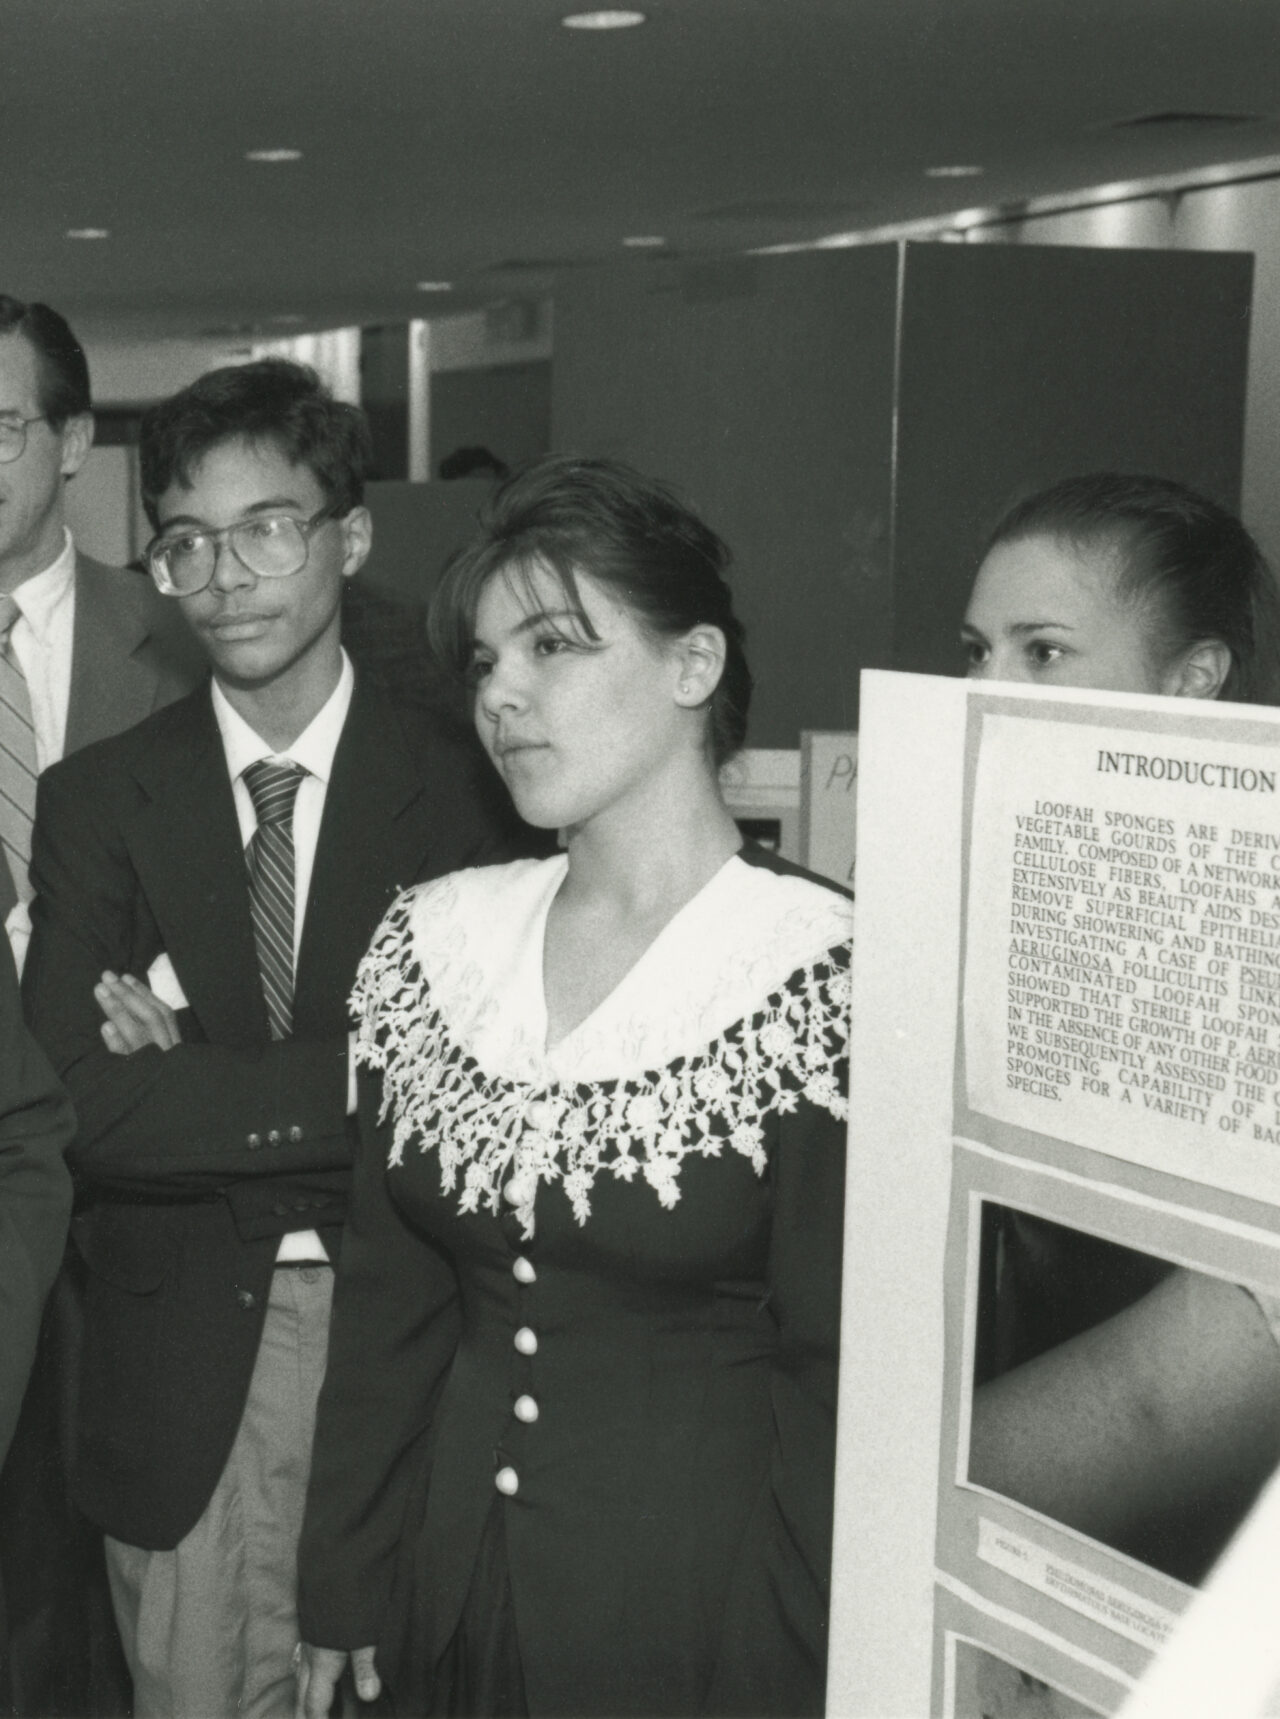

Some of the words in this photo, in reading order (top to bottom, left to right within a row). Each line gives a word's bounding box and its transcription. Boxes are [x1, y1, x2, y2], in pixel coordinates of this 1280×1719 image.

[1096, 750, 1277, 793] INTRODUCTION
[1015, 815, 1100, 842] VEGETABLE
[1111, 830, 1176, 854] GOURDS
[1189, 842, 1211, 859] OF
[1224, 847, 1257, 868] THE
[1035, 800, 1094, 823] LOOFAH
[1104, 811, 1175, 836] SPONGES
[1186, 823, 1218, 842] ARE
[1013, 850, 1096, 878] CELLULOSE
[1109, 866, 1166, 892] FIBERS,
[1180, 878, 1256, 906] LOOFAHS
[1014, 833, 1069, 855] FAMILY.
[1078, 843, 1158, 870] COMPOSED
[1162, 857, 1182, 874] OF
[1187, 862, 1198, 877] A
[1012, 885, 1073, 910] REMOVE
[1086, 899, 1186, 931] SUPERFICIAL
[1013, 867, 1106, 897] EXTENSIVELY
[1113, 886, 1131, 902] AS
[1138, 889, 1198, 914] BEAUTY
[1204, 903, 1242, 922] AIDS
[1010, 920, 1127, 956] INVESTIGATING
[1137, 945, 1147, 960] A
[1158, 949, 1197, 971] CASE
[1208, 959, 1229, 976] OF
[1011, 902, 1066, 926] DURING
[1073, 914, 1164, 945] SHOWERING
[1171, 934, 1206, 953] AND
[1008, 954, 1137, 993] CONTAMINATED
[1153, 984, 1219, 1013] LOOFAH
[1009, 938, 1112, 973] AERUGINOSA
[1123, 960, 1228, 996] FOLLICULITIS
[1008, 971, 1070, 997] SHOWED
[1080, 986, 1122, 1009] THAT
[1131, 998, 1191, 1026] STERILE
[1202, 1014, 1268, 1044] LOOFAH
[1008, 988, 1089, 1019] SUPPORTED
[1094, 1007, 1123, 1028] THE
[1129, 1016, 1195, 1045] GROWTH
[1201, 1033, 1222, 1051] OF
[1227, 1039, 1240, 1058] P.
[1007, 1022, 1029, 1040] WE
[1035, 1029, 1146, 1070] SUBSEQUENTLY
[1154, 1060, 1226, 1092] ASSESSED
[1234, 1079, 1265, 1103] THE
[1008, 1005, 1021, 1020] IN
[1026, 1009, 1053, 1029] THE
[1057, 1018, 1119, 1046] ABSENCE
[1122, 1033, 1142, 1050] OF
[1145, 1040, 1176, 1059] ANY
[1179, 1047, 1230, 1073] OTHER
[1234, 1060, 1278, 1086] FOOD
[1007, 1039, 1100, 1076] PROMOTING
[1119, 1068, 1213, 1107] CAPABILITY
[1232, 1099, 1255, 1119] OF
[1007, 1073, 1062, 1102] SPECIES.
[1007, 1056, 1071, 1086] SPONGES
[1081, 1076, 1110, 1097] FOR
[1121, 1088, 1132, 1104] A
[1143, 1093, 1208, 1125] VARIETY
[1219, 1115, 1241, 1133] OF
